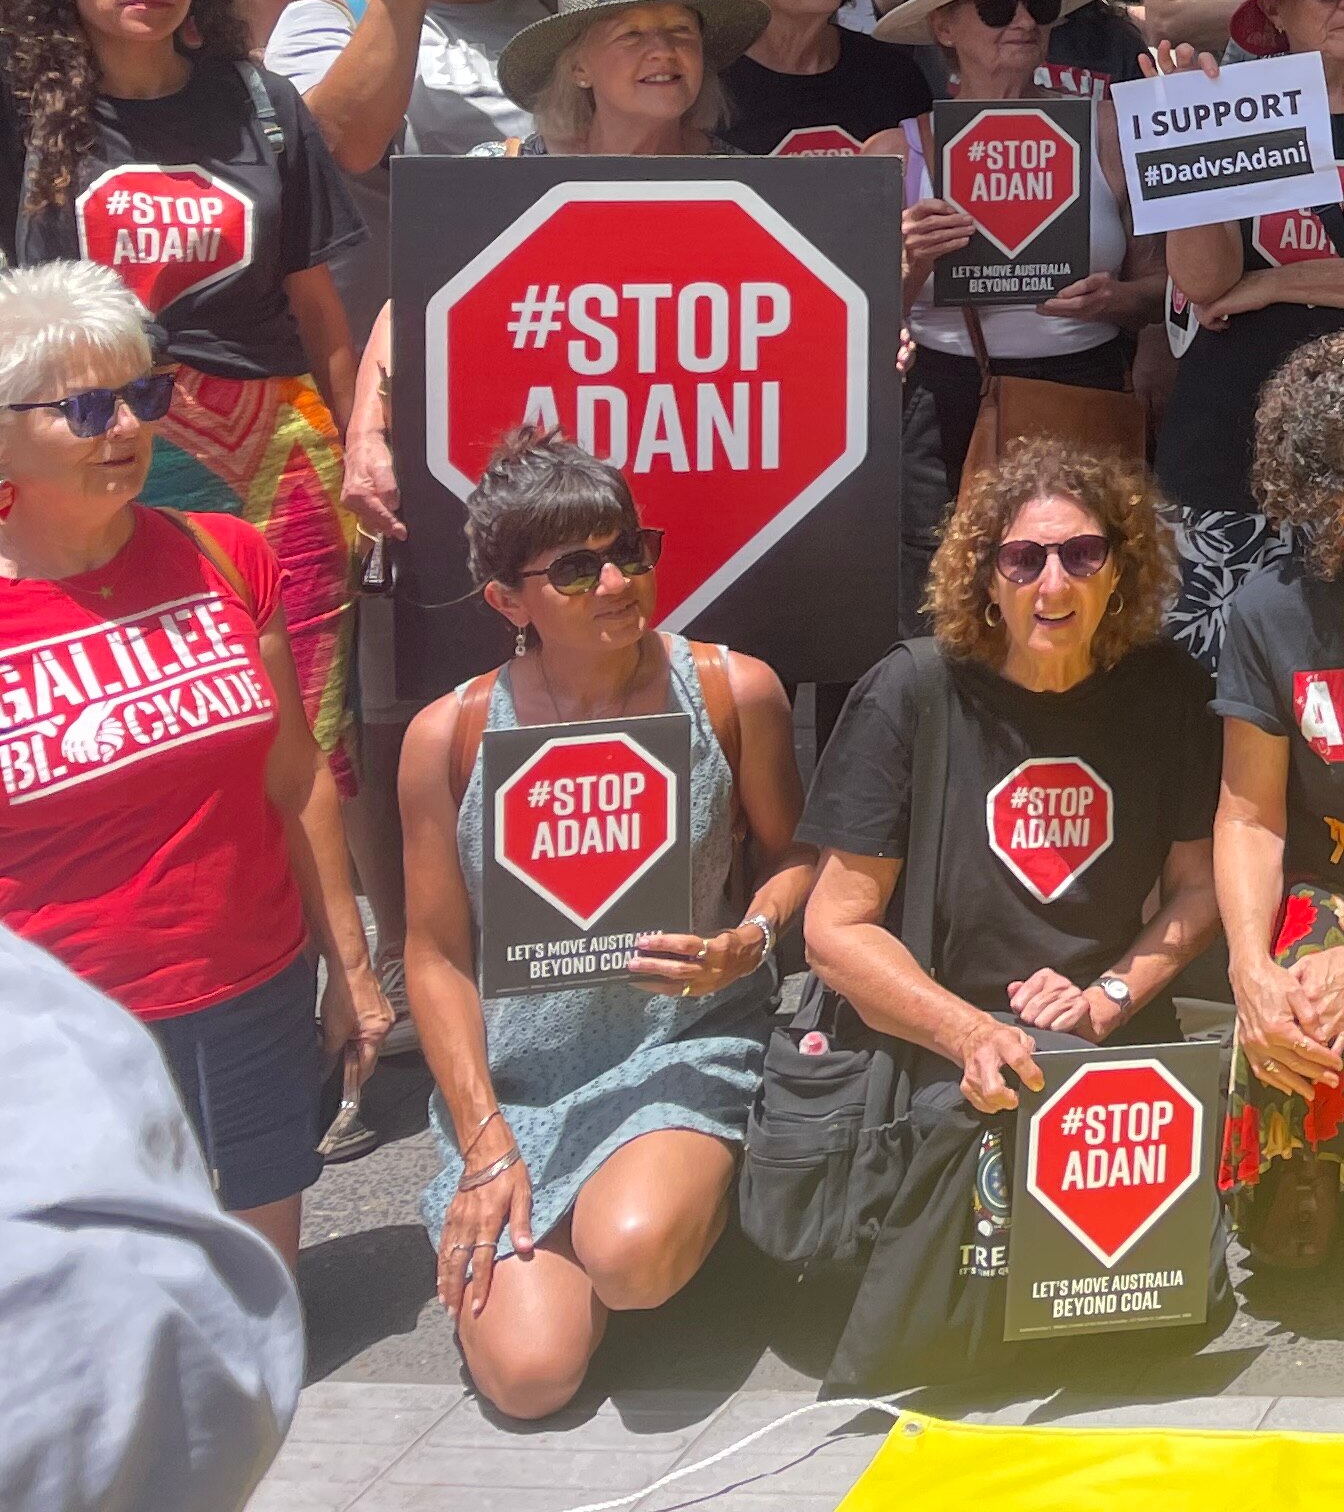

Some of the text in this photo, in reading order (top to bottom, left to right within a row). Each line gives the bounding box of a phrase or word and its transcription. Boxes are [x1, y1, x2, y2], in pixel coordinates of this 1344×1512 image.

[1132, 89, 1302, 140] I SUPPORT
[968, 140, 1056, 170] #STOP
[1144, 140, 1308, 188] #DadvsAdani
[970, 172, 1053, 202] ADANI
[106, 190, 223, 225] #STOP
[113, 226, 222, 265] ADANI
[952, 263, 1071, 279] LET'S MOVE AUSTRALIA
[969, 278, 1054, 293] BEYOND COAL
[507, 281, 791, 375] #STOP
[0, 601, 246, 728] GALILEE
[528, 771, 646, 819] #STOP
[1011, 785, 1094, 820] #STOP
[530, 816, 642, 861] ADANI
[1011, 817, 1090, 850] ADANI
[507, 943, 544, 962] LET'S
[547, 938, 587, 958] MOVE
[529, 954, 596, 979] BEYOND
[1060, 1100, 1173, 1145] #STOP
[1061, 1144, 1167, 1191] ADANI
[1032, 1270, 1184, 1299] LET'S MOVE AUSTRALIA
[1053, 1290, 1162, 1318] BEYOND COAL
